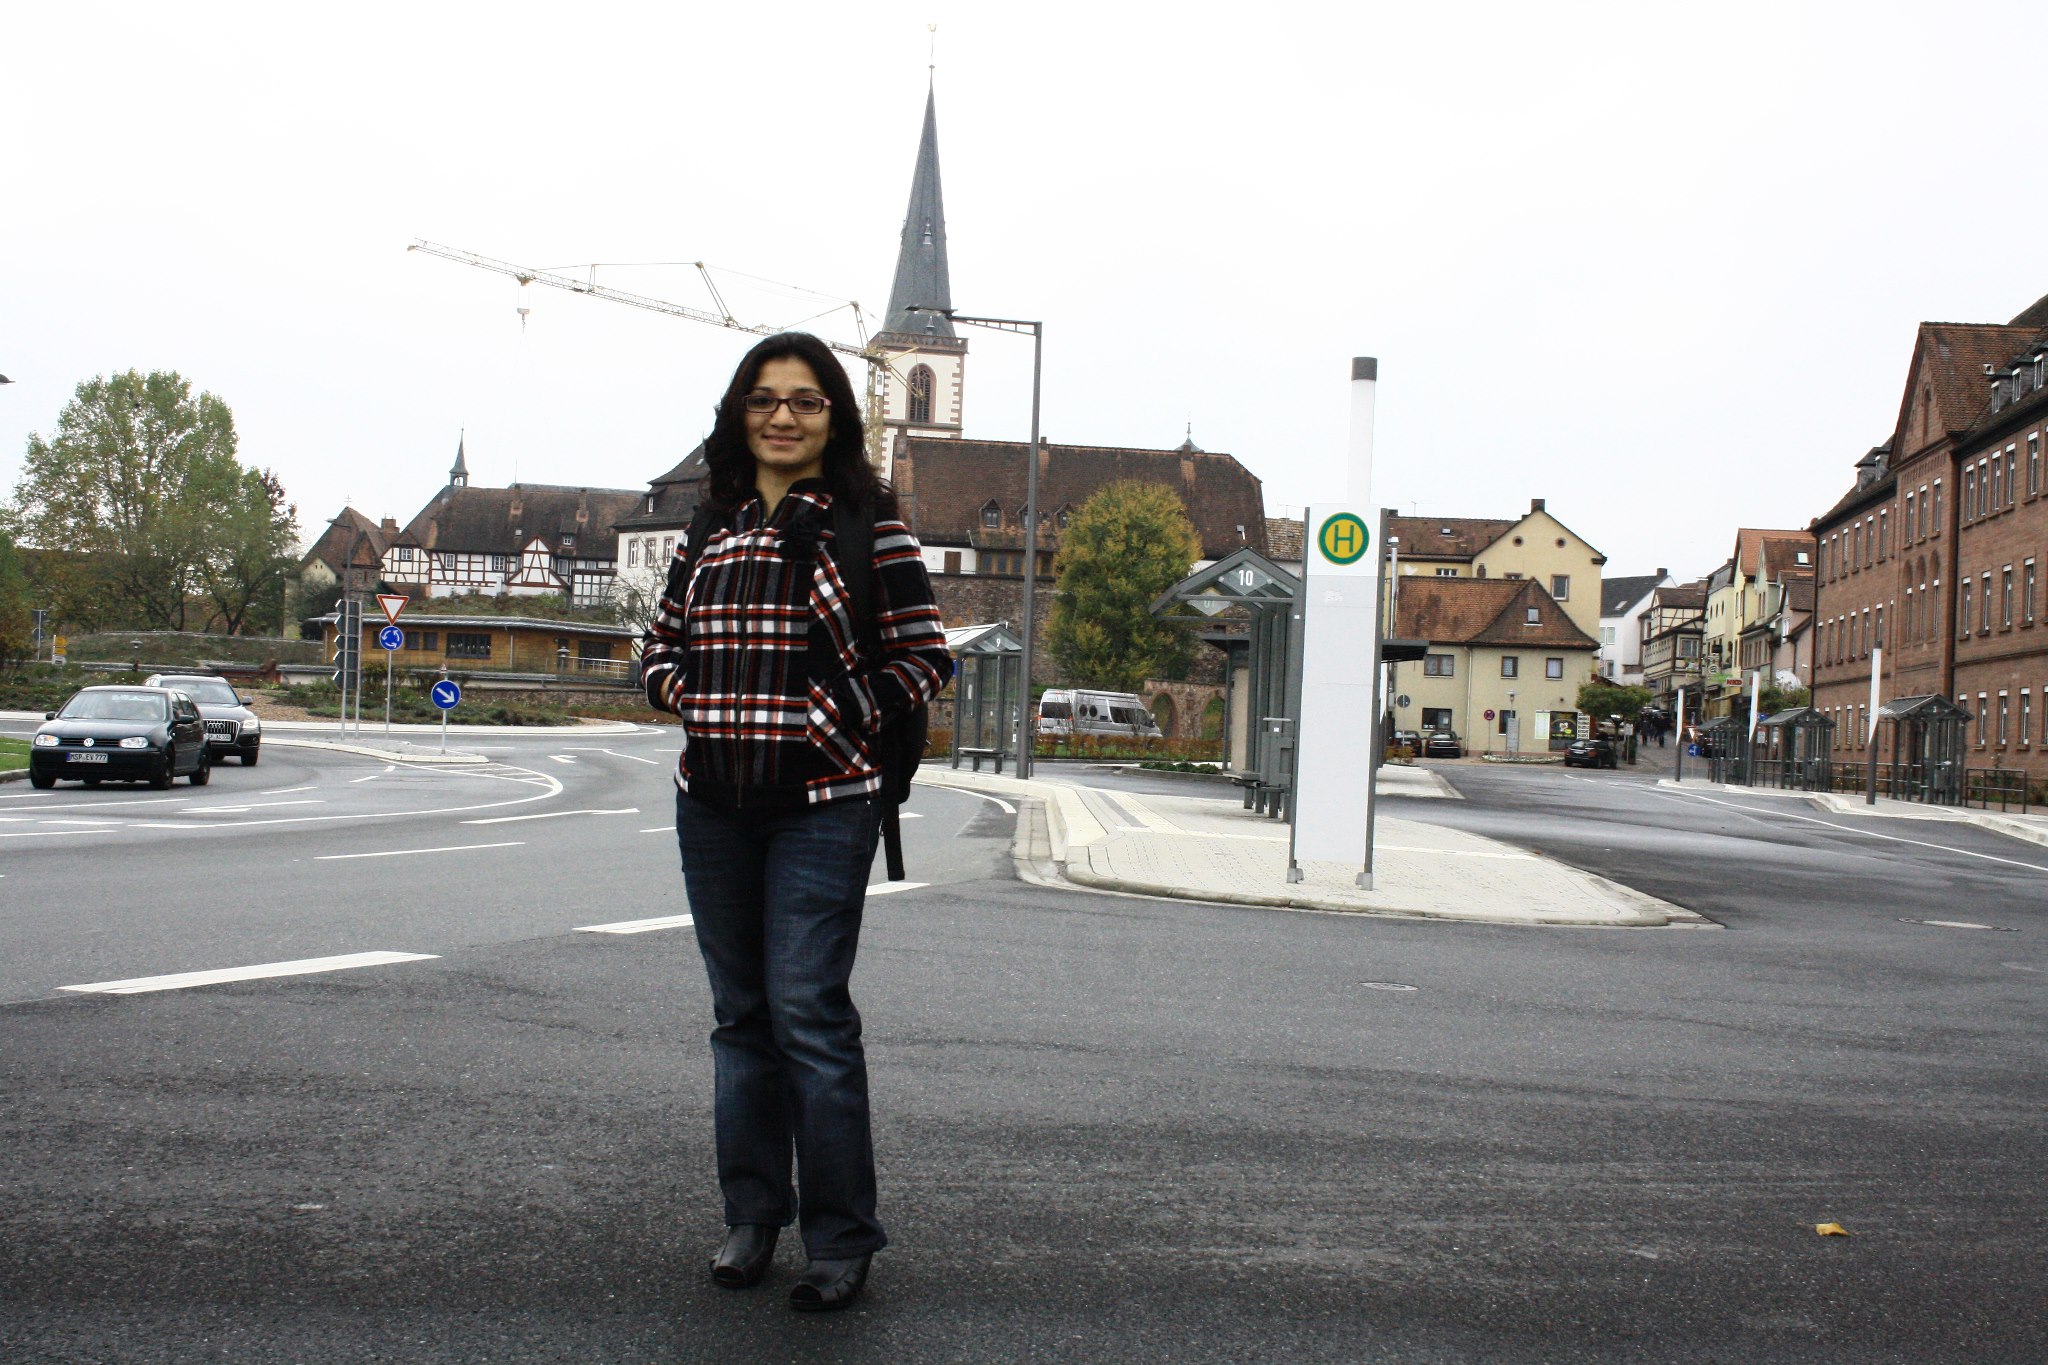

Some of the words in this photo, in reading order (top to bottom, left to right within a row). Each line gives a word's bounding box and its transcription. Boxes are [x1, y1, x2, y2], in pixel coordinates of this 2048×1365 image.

[1333, 524, 1354, 553] H
[1238, 569, 1254, 586] 10
[996, 638, 1001, 648] 9
